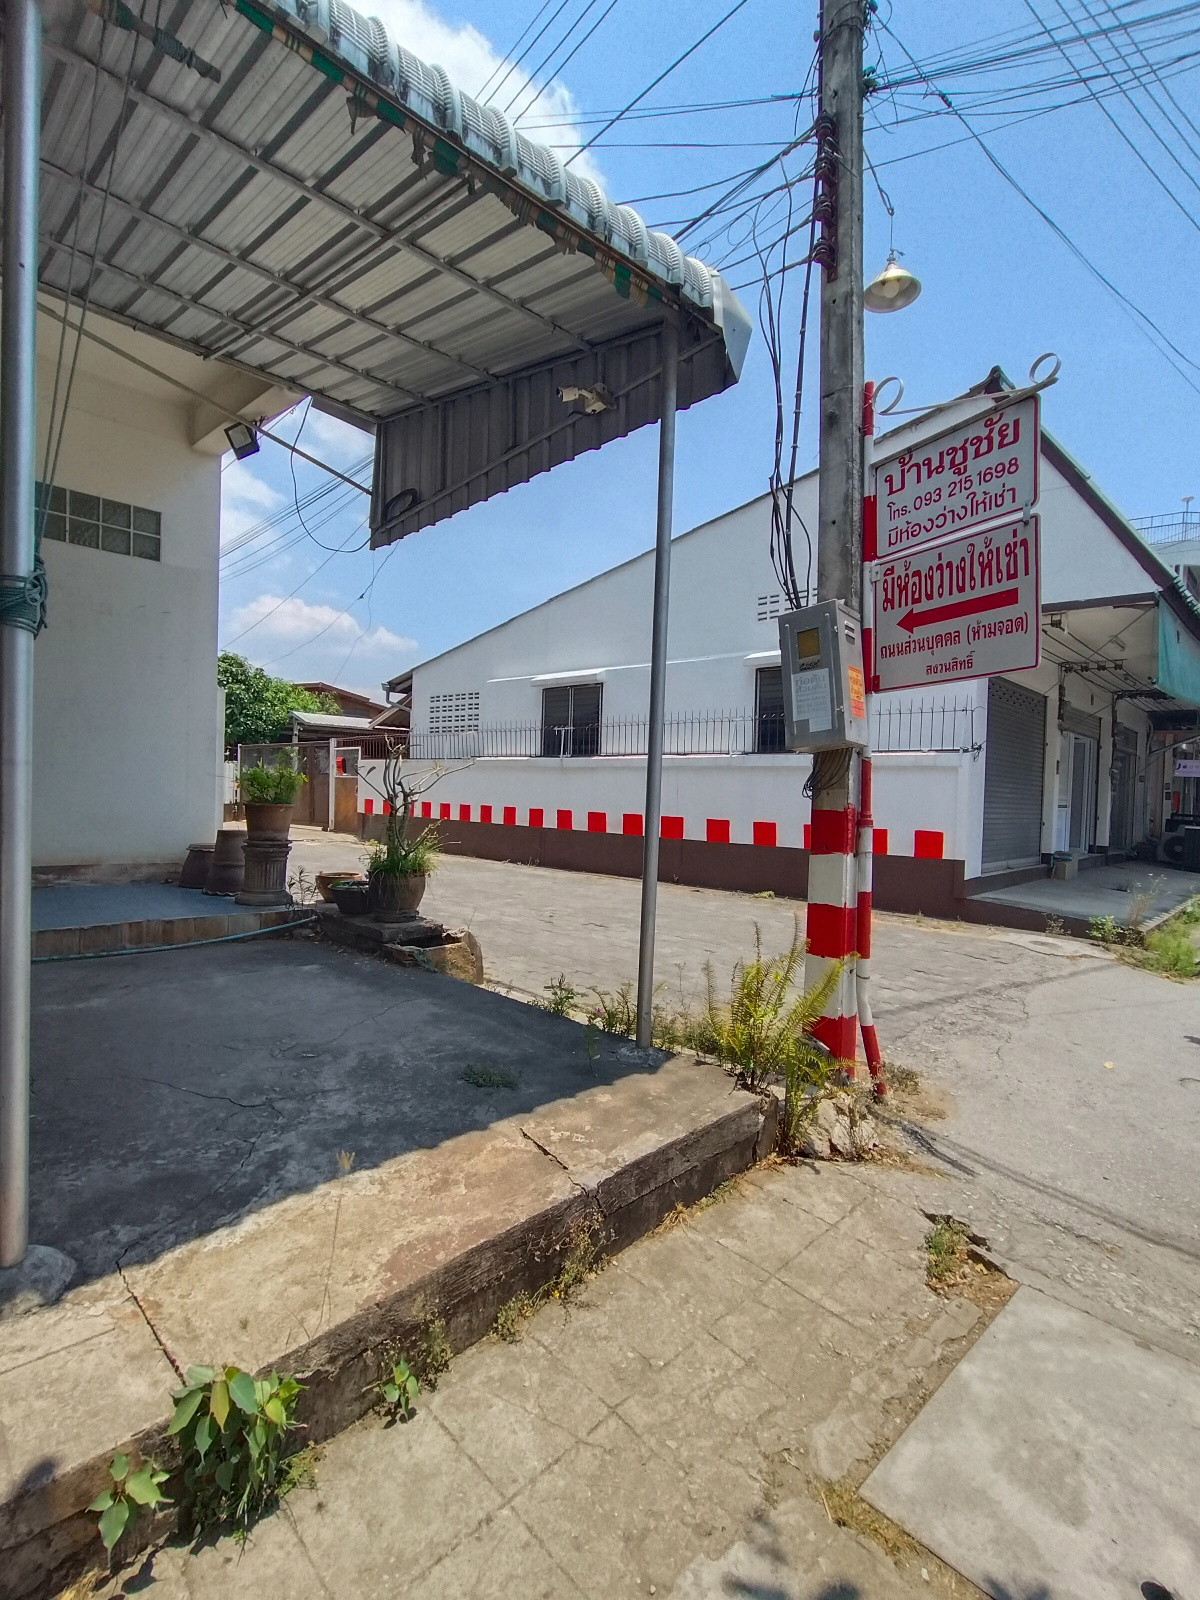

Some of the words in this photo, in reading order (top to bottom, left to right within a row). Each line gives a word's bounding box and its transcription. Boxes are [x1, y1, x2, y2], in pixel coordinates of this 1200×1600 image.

[884, 412, 1021, 496] บ้านชูชัย
[886, 502, 911, 521] โทร.
[913, 487, 942, 511] 093
[947, 475, 974, 498] 215
[977, 457, 1020, 487] 1698
[888, 483, 1017, 548] มีห้องว่างให้เช่า
[882, 528, 1030, 612] มีห้องว่างให้เช่า
[880, 629, 961, 659] ถนนส่วนบุคคล
[966, 611, 1029, 645] (ห้ามจอด)
[925, 650, 975, 675] สงวนสิทธิ์
